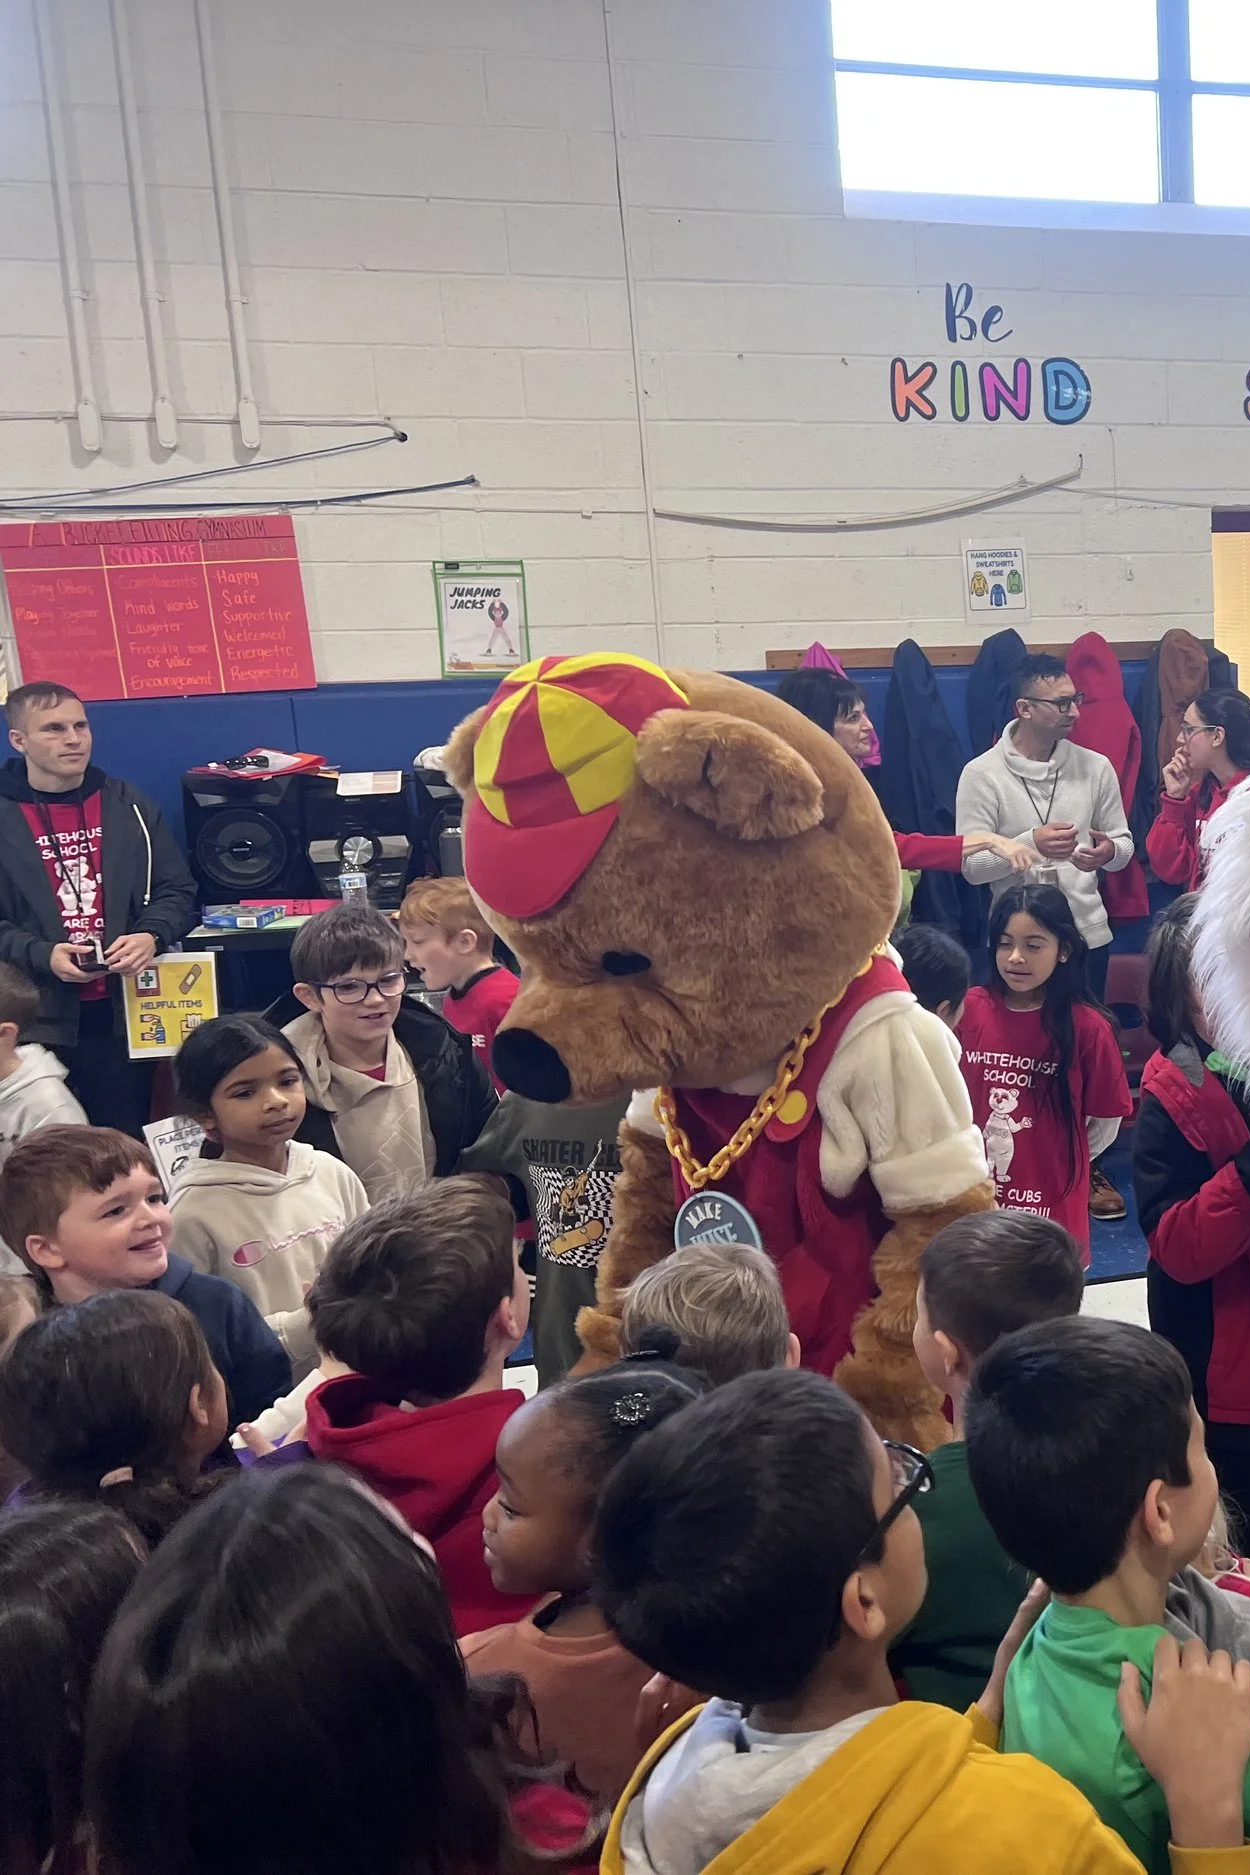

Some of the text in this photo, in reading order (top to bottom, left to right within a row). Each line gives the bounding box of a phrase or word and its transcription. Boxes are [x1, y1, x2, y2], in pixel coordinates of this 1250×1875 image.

[944, 282, 1013, 344] Be
[890, 356, 1092, 425] KIND
[127, 519, 195, 543] FILLING
[196, 517, 267, 542] GYMNASIUM
[970, 551, 987, 559] HANG
[975, 560, 1015, 568] SWEATSHIRTS
[215, 568, 261, 586] Happy
[988, 569, 1004, 577] HERE
[222, 589, 257, 608] Safe
[449, 586, 502, 598] JUMPING
[124, 598, 157, 616] Kind
[450, 598, 486, 610] JACKS
[222, 607, 294, 628] Supportive
[126, 620, 183, 638] Laughter
[129, 641, 179, 658] Friendly
[226, 644, 296, 665] Energetic
[146, 654, 161, 669] of
[129, 670, 213, 691] Encouragement
[230, 661, 300, 684] Respected
[140, 1000, 203, 1010] HELPFUL ITEMS
[983, 1069, 1035, 1089] SCHOOL
[522, 1138, 586, 1166] SKATER
[1007, 1188, 1042, 1203] CUBS
[685, 1201, 722, 1230] MAKE
